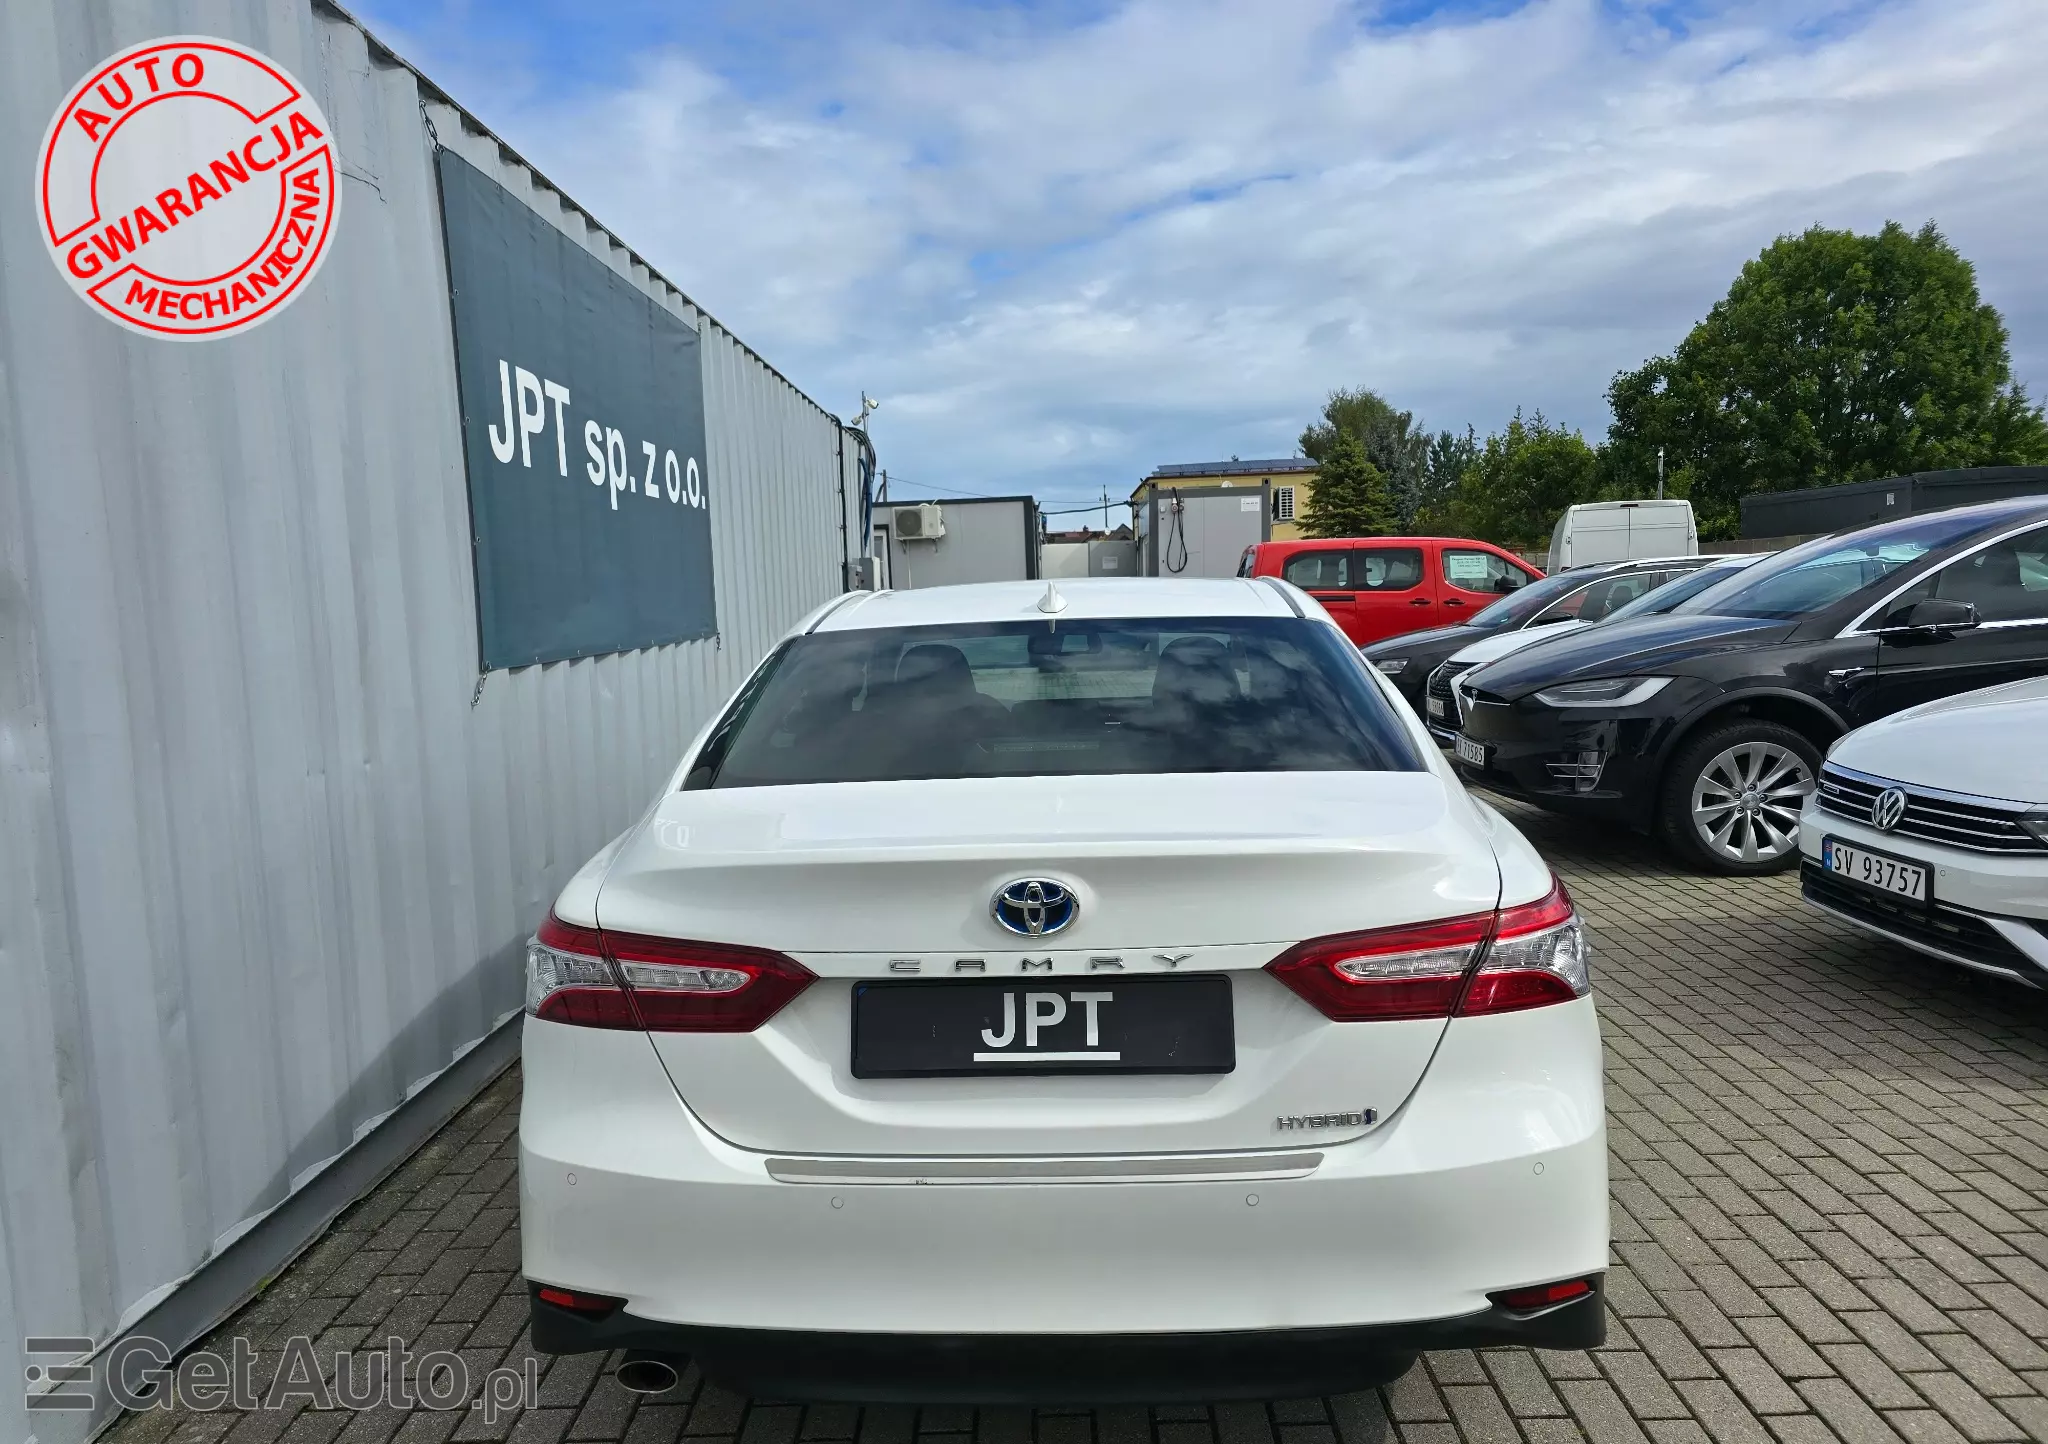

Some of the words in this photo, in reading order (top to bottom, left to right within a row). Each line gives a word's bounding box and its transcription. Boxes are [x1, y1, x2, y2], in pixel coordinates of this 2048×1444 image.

[488, 359, 571, 477] JPT
[584, 420, 636, 510] sp.
[642, 440, 660, 498] z
[665, 449, 706, 509] o.o.
[1463, 741, 1483, 763] 71585
[1834, 847, 1854, 875] SV
[1863, 856, 1922, 896] 93757
[889, 953, 1195, 972] CAMRY
[980, 991, 1113, 1048] JPT
[1277, 1112, 1362, 1130] HYBRID
